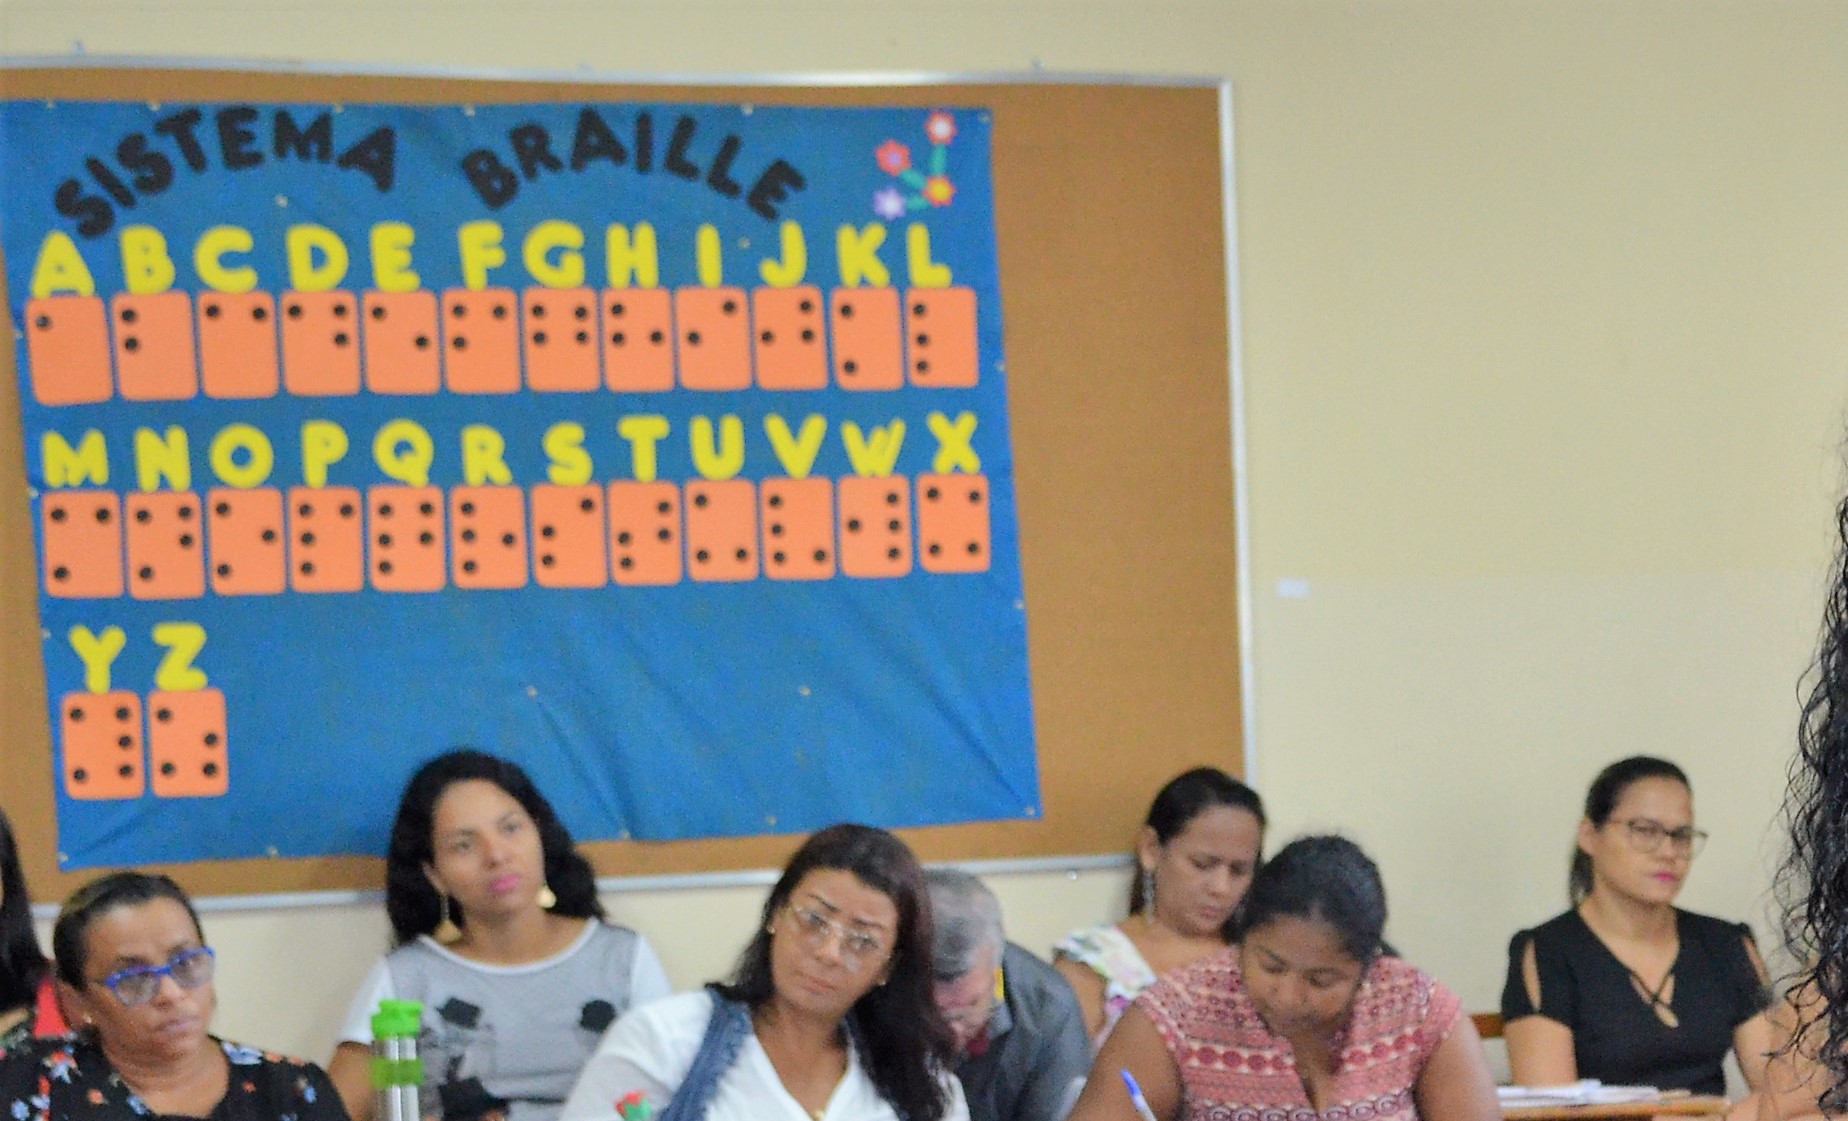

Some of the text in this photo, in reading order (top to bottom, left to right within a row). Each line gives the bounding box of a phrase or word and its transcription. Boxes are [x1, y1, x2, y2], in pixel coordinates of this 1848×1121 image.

[53, 104, 807, 240] SISTEMA BRAILLE
[32, 221, 952, 300] A B C D E F G H I J K L
[43, 413, 980, 493] M N O P Q R S T U V W X
[70, 623, 207, 695] Y Z
